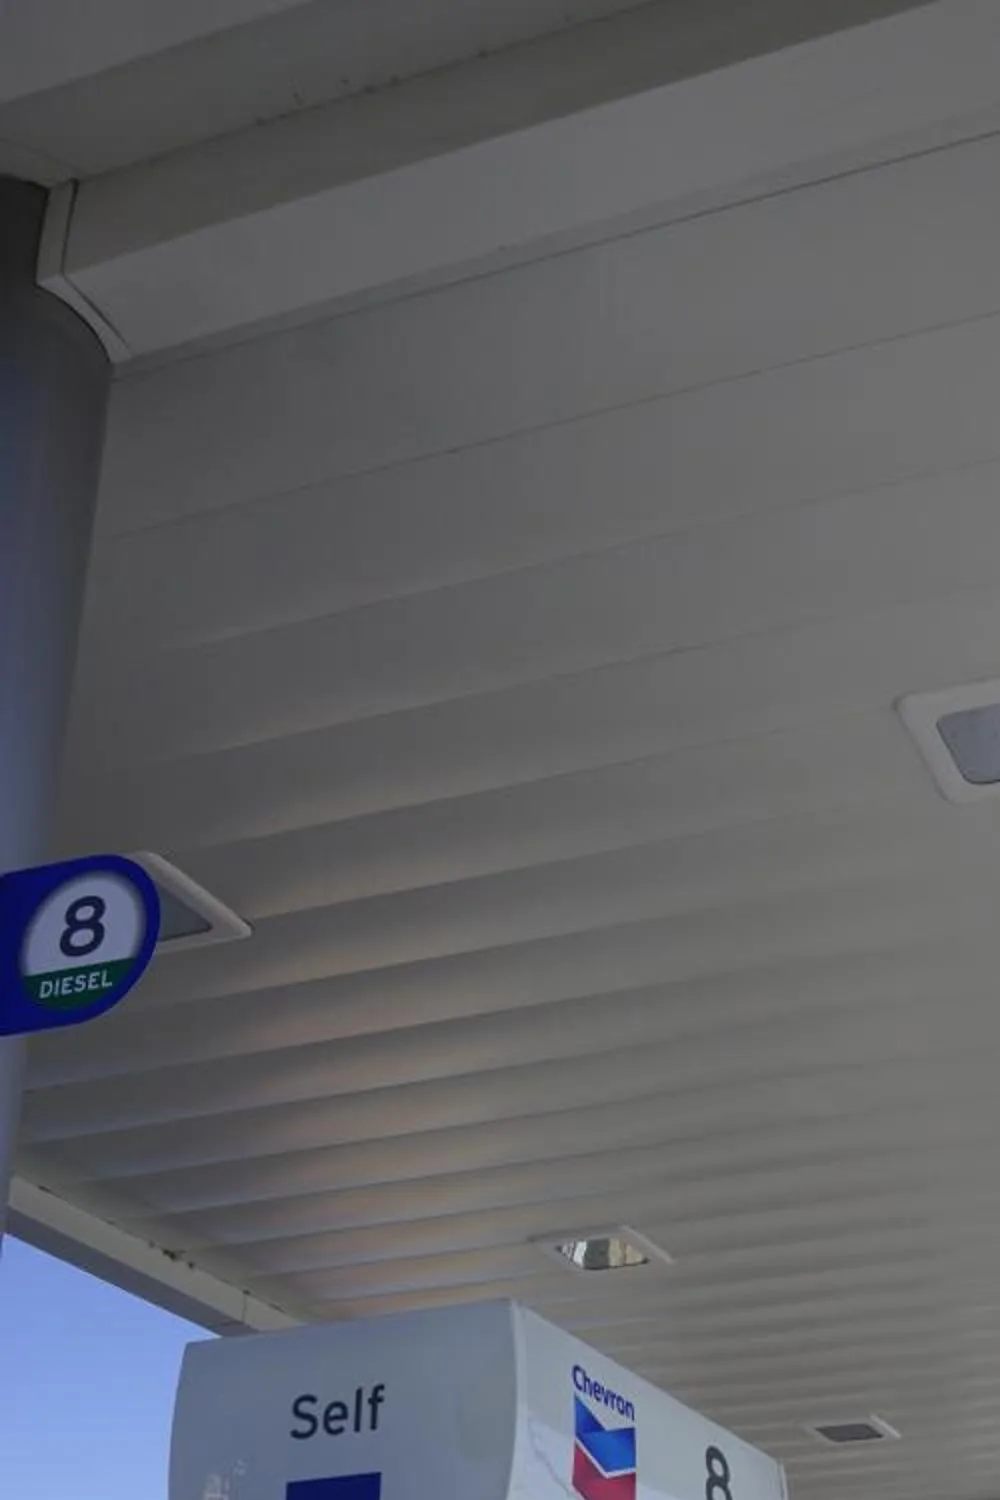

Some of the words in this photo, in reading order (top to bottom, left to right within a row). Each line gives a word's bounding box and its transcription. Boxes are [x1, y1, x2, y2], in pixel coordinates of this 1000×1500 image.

[59, 895, 106, 957] 8
[39, 969, 113, 999] DIESEL
[290, 1385, 385, 1440] Self
[572, 1364, 635, 1422] Chevron
